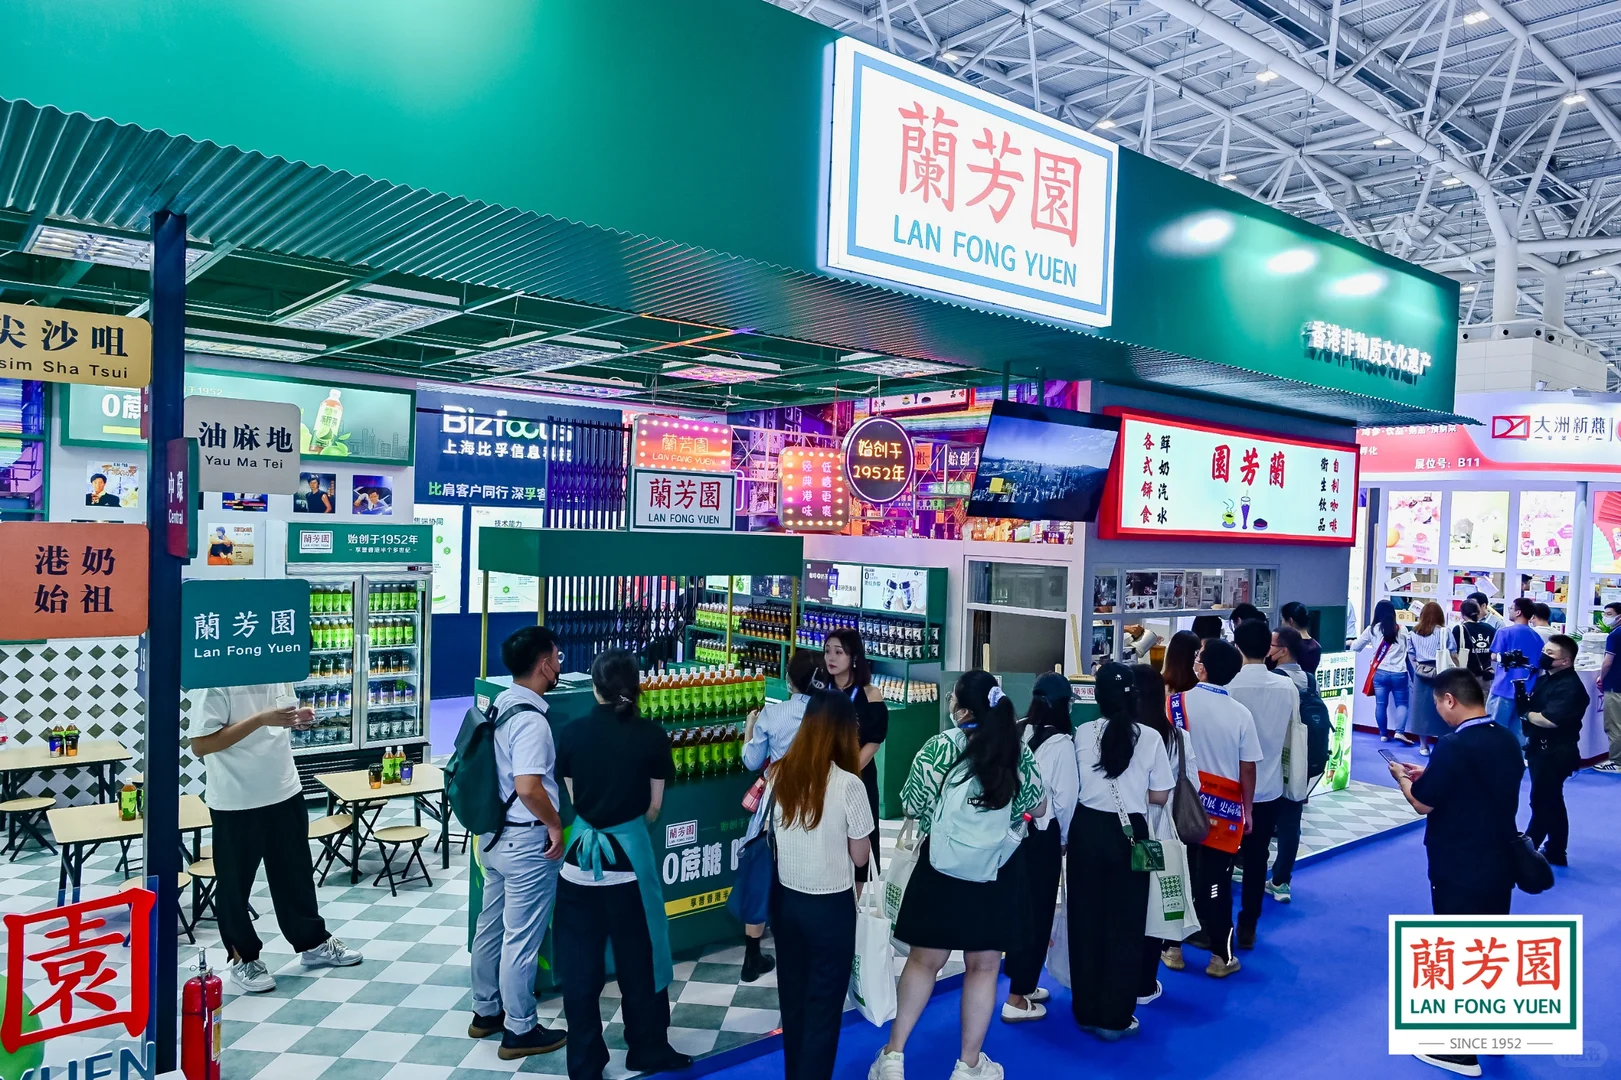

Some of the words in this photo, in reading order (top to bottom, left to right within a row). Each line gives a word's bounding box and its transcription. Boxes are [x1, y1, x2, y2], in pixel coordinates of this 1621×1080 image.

[898, 100, 1082, 248] 蘭芳園
[893, 214, 941, 252] LAN
[953, 230, 1016, 272] FONG
[1025, 250, 1077, 287] YUEN
[0, 314, 129, 358] 尖沙咀
[1310, 320, 1432, 376] 香港非物质文化遗产
[43, 361, 79, 375] Sha
[89, 364, 128, 379] Tsui
[1534, 415, 1606, 435] 大洲新燕
[198, 421, 294, 453] 油麻地
[662, 432, 709, 455] 蘭芳園
[858, 438, 903, 459] 始创于
[205, 455, 231, 467] Yau
[236, 456, 258, 468] Ma
[264, 458, 284, 469] Tei
[853, 464, 906, 482] 1952年
[1457, 458, 1480, 468] B11
[428, 481, 509, 500] 比肩客户同行
[649, 477, 721, 512] 蘭芳園
[801, 460, 813, 517] 经典港味
[168, 509, 184, 525] Central
[494, 519, 523, 528] 技术能力
[648, 513, 666, 522] LAN
[670, 513, 695, 524] FONG
[698, 514, 720, 524] YUEN
[35, 545, 116, 577] 港奶
[34, 584, 115, 615] 始祖
[193, 608, 297, 641] 蘭芳園
[193, 646, 220, 660] Lan
[227, 644, 262, 661] Fong
[267, 642, 302, 656] Yuen
[662, 842, 723, 885] 0蔗糖
